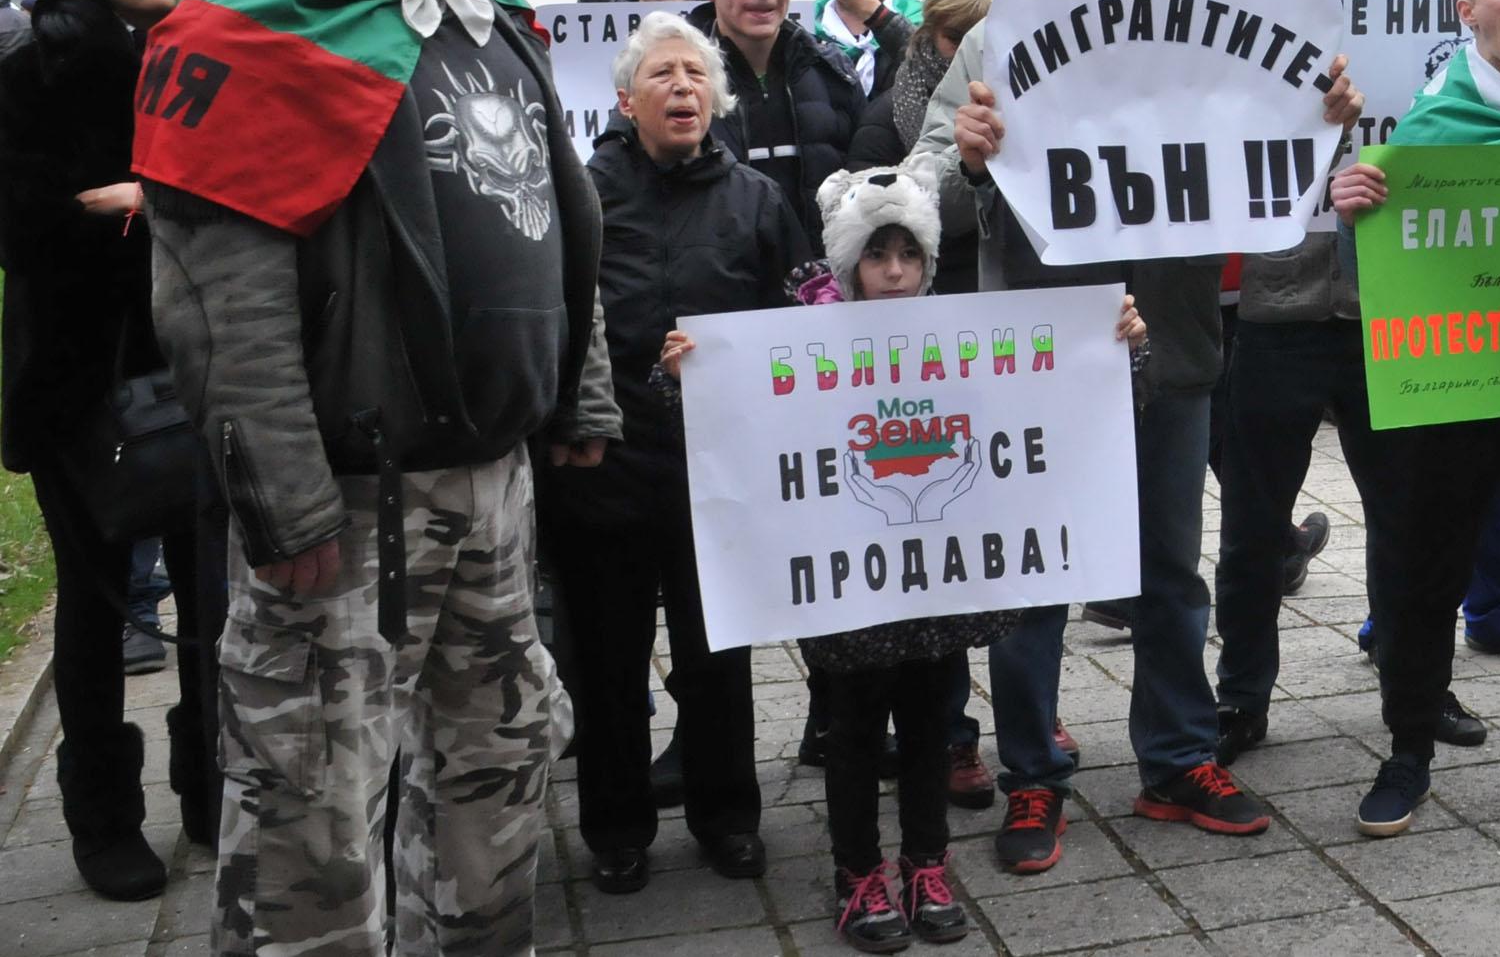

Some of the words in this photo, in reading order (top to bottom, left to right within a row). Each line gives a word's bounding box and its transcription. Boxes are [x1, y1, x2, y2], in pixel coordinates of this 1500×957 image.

[1046, 142, 1211, 230] ВЪН
[769, 323, 1055, 396] БЪЛГАРИЯ
[848, 413, 971, 452] Земя
[877, 397, 935, 420] Моя
[779, 447, 839, 501] НЕ
[989, 426, 1047, 479] СЕ
